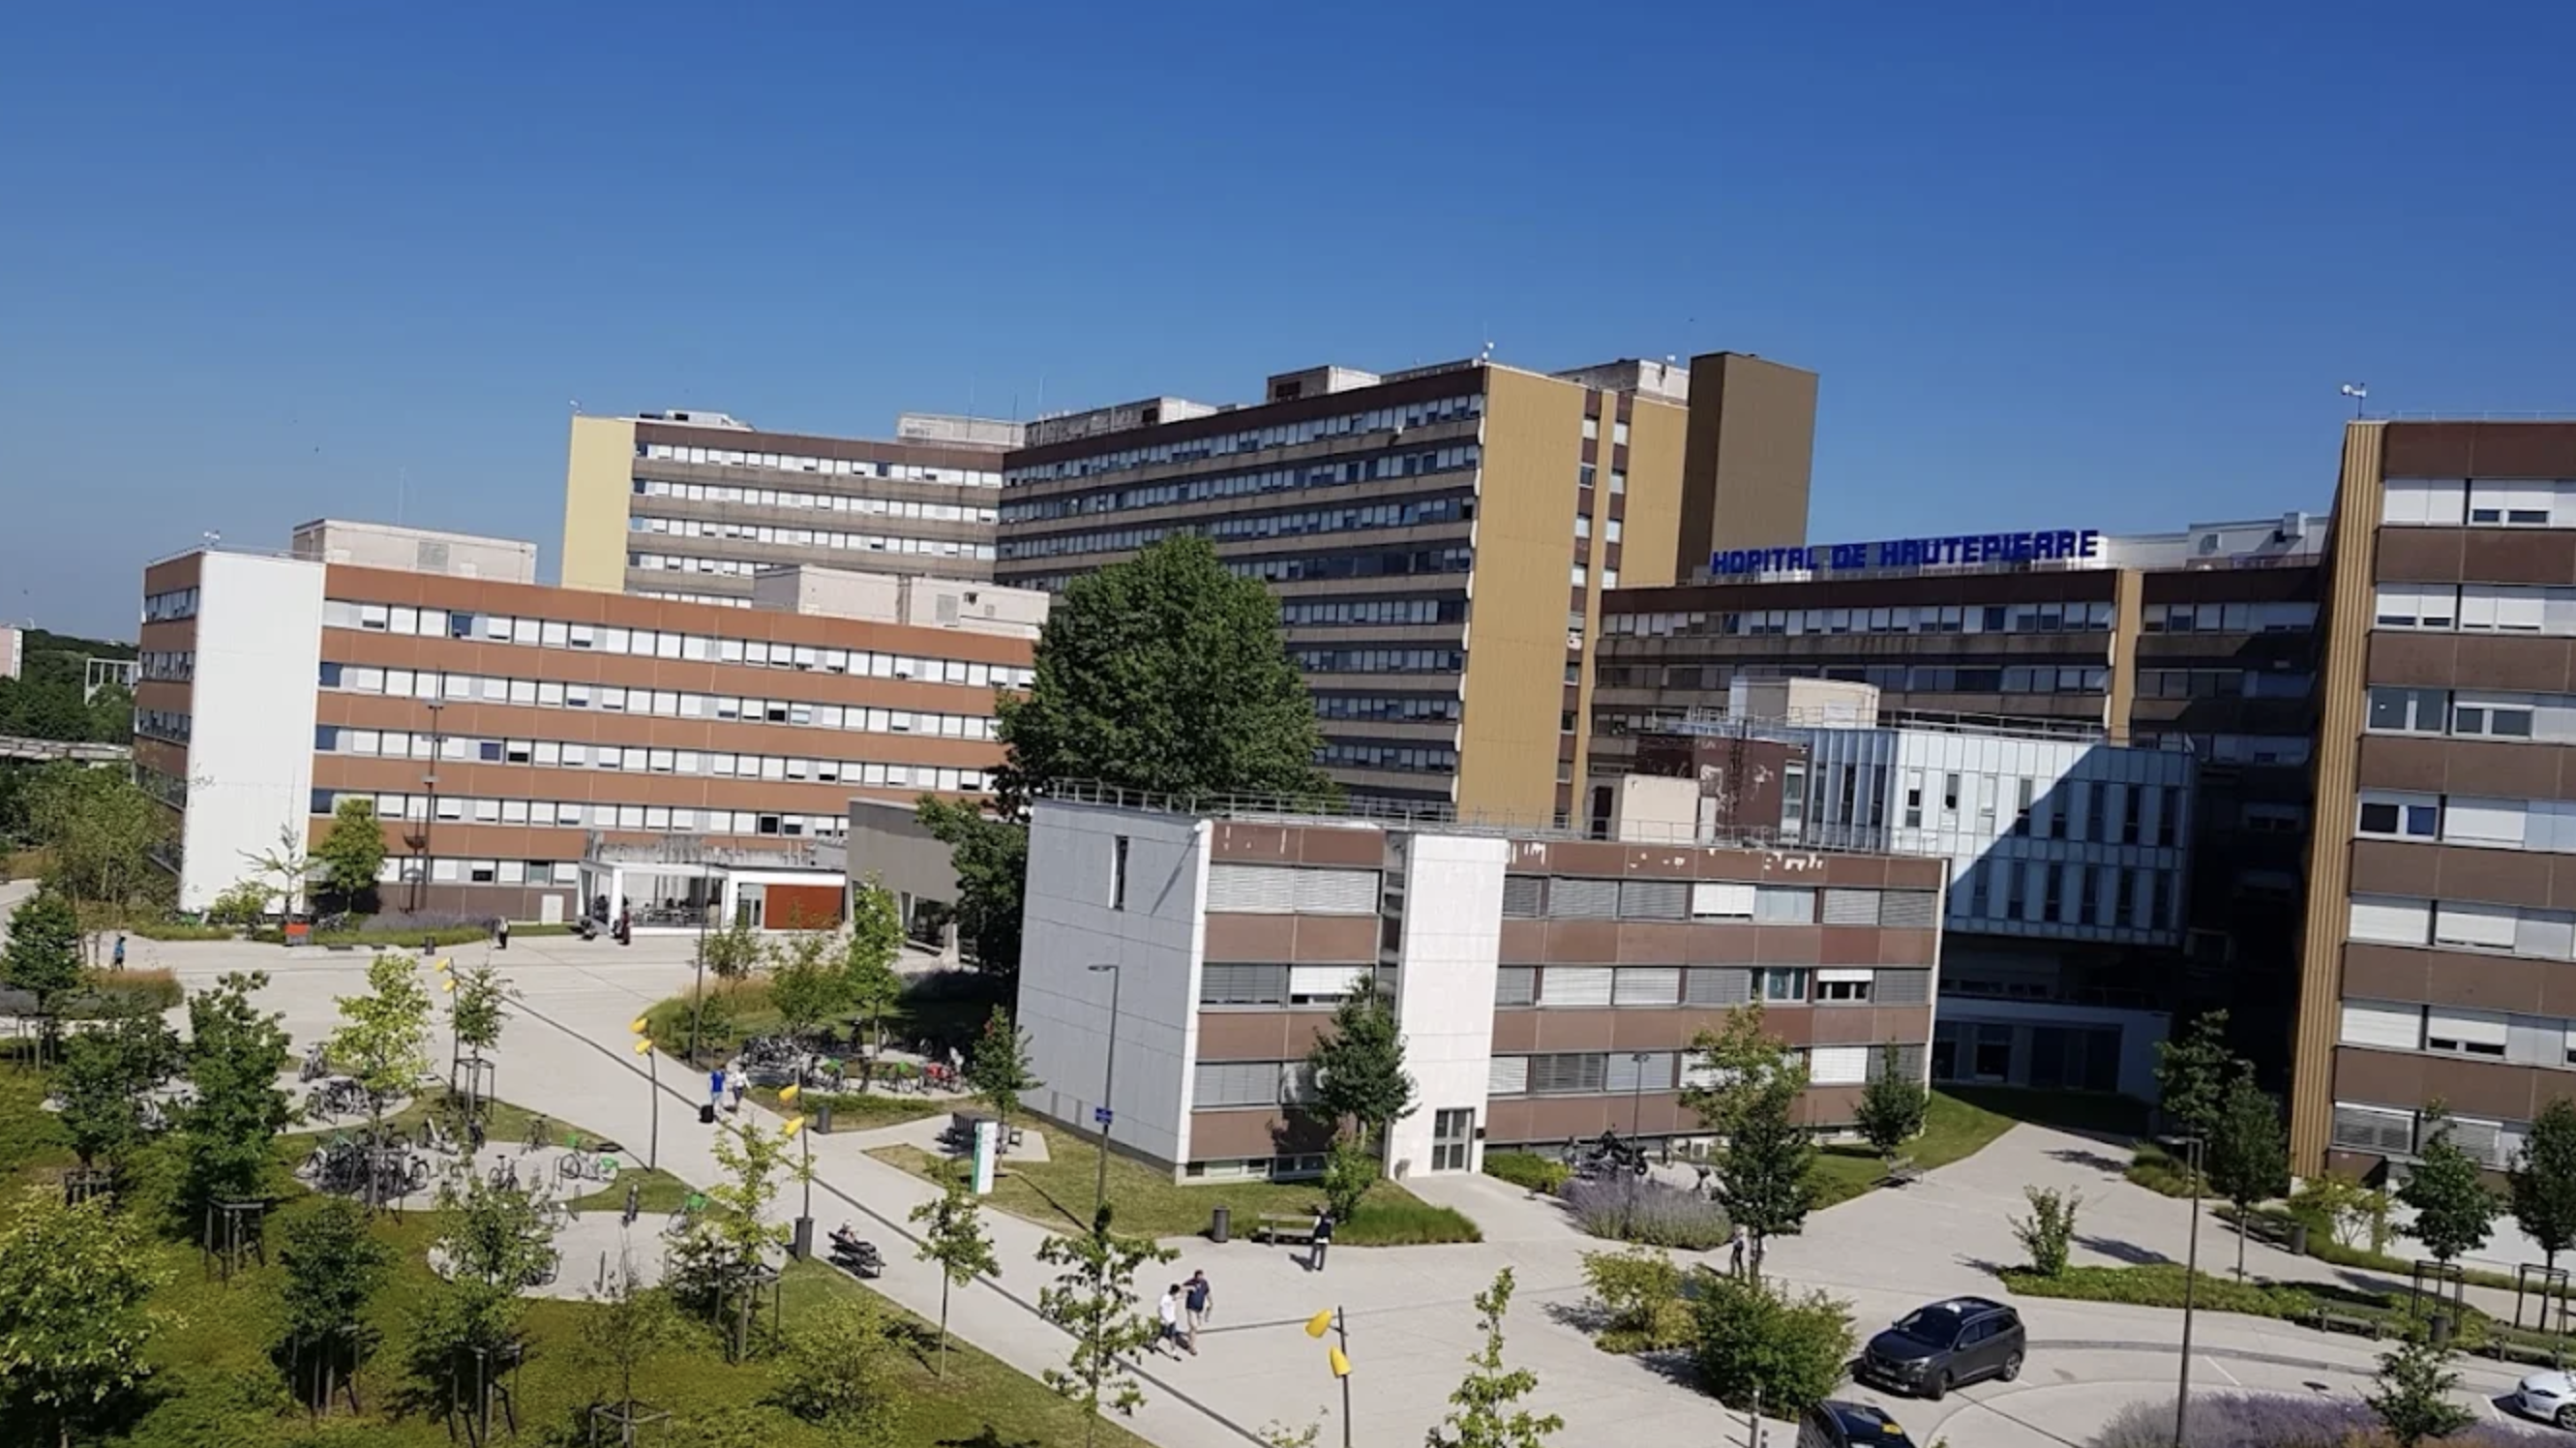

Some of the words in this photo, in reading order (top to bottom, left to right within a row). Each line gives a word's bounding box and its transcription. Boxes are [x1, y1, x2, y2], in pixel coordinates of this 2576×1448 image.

[1712, 547, 1818, 575] HOPITAL
[1831, 543, 1867, 569] DE
[1880, 529, 2098, 566] HAUTEPIERRE
